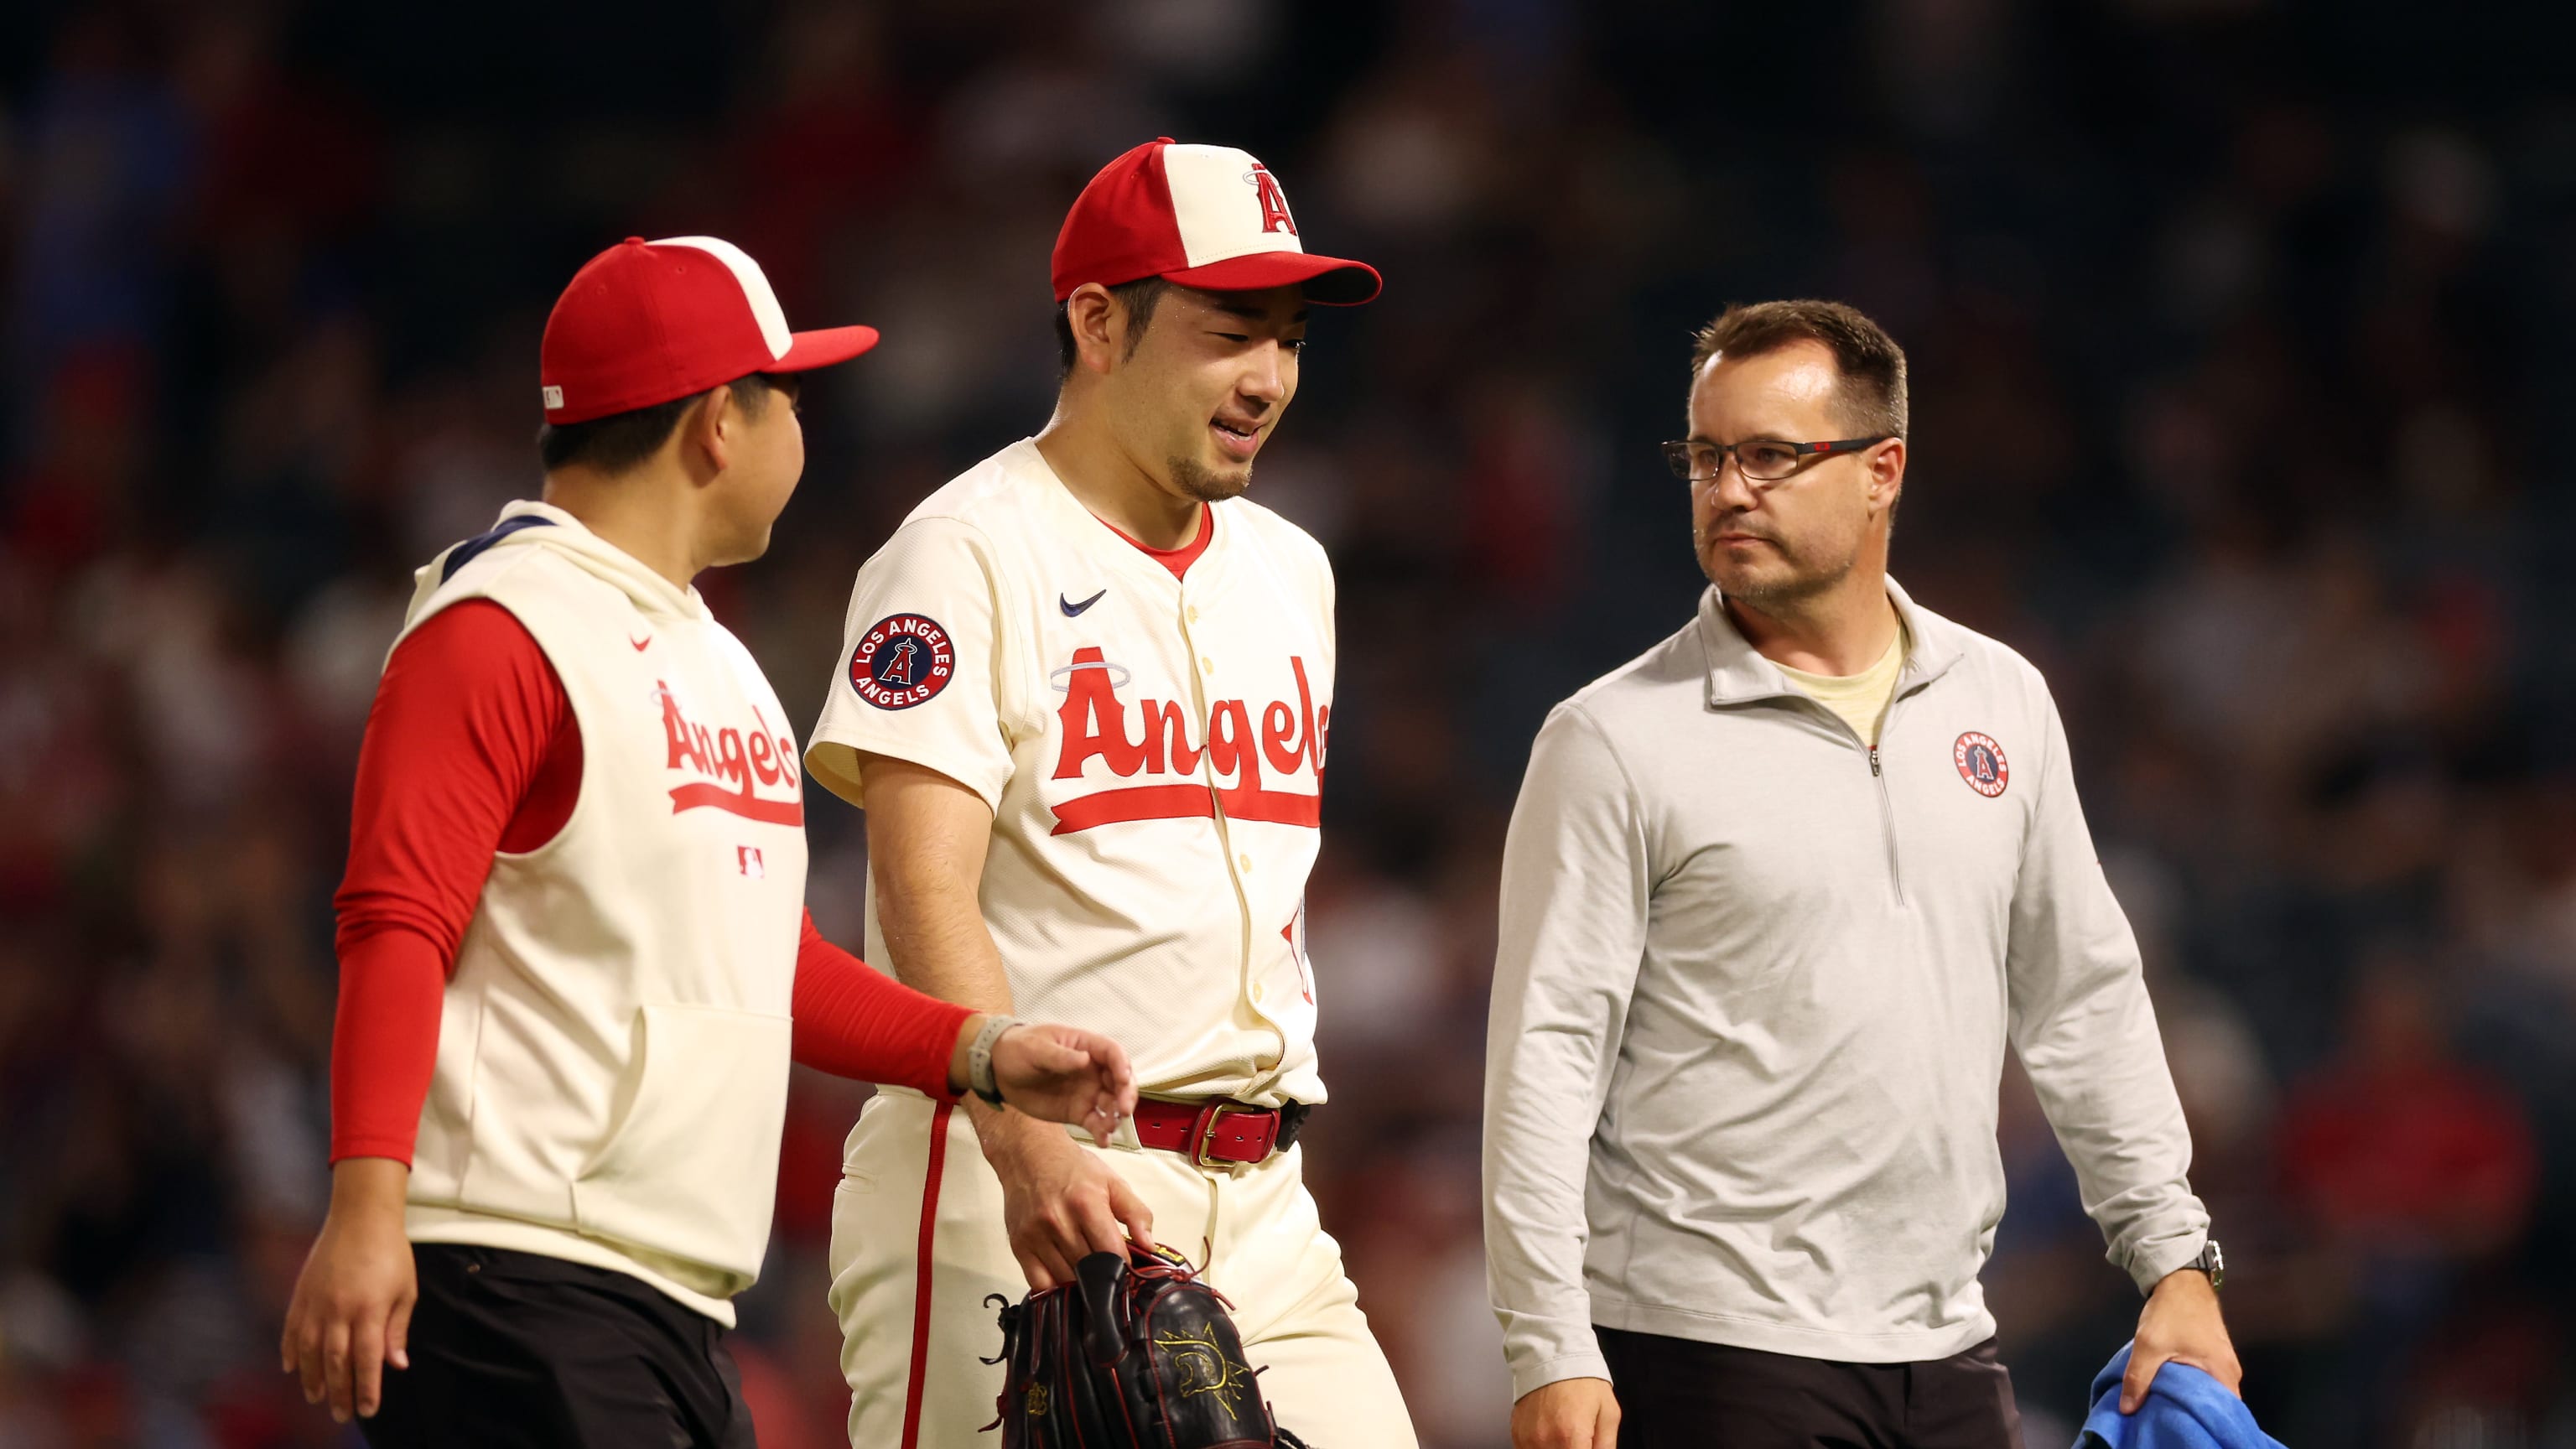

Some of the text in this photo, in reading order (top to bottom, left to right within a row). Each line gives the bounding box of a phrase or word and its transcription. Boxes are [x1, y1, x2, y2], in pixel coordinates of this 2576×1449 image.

[1250, 163, 1297, 236] A
[856, 618, 950, 678] LOS ANGELES
[880, 637, 917, 685] A
[855, 676, 930, 705] ANGELS
[657, 678, 802, 802] Angels
[1956, 734, 2007, 771] LOS ANGELES
[1975, 745, 1994, 780] A
[1966, 776, 2004, 795] ANGELS
